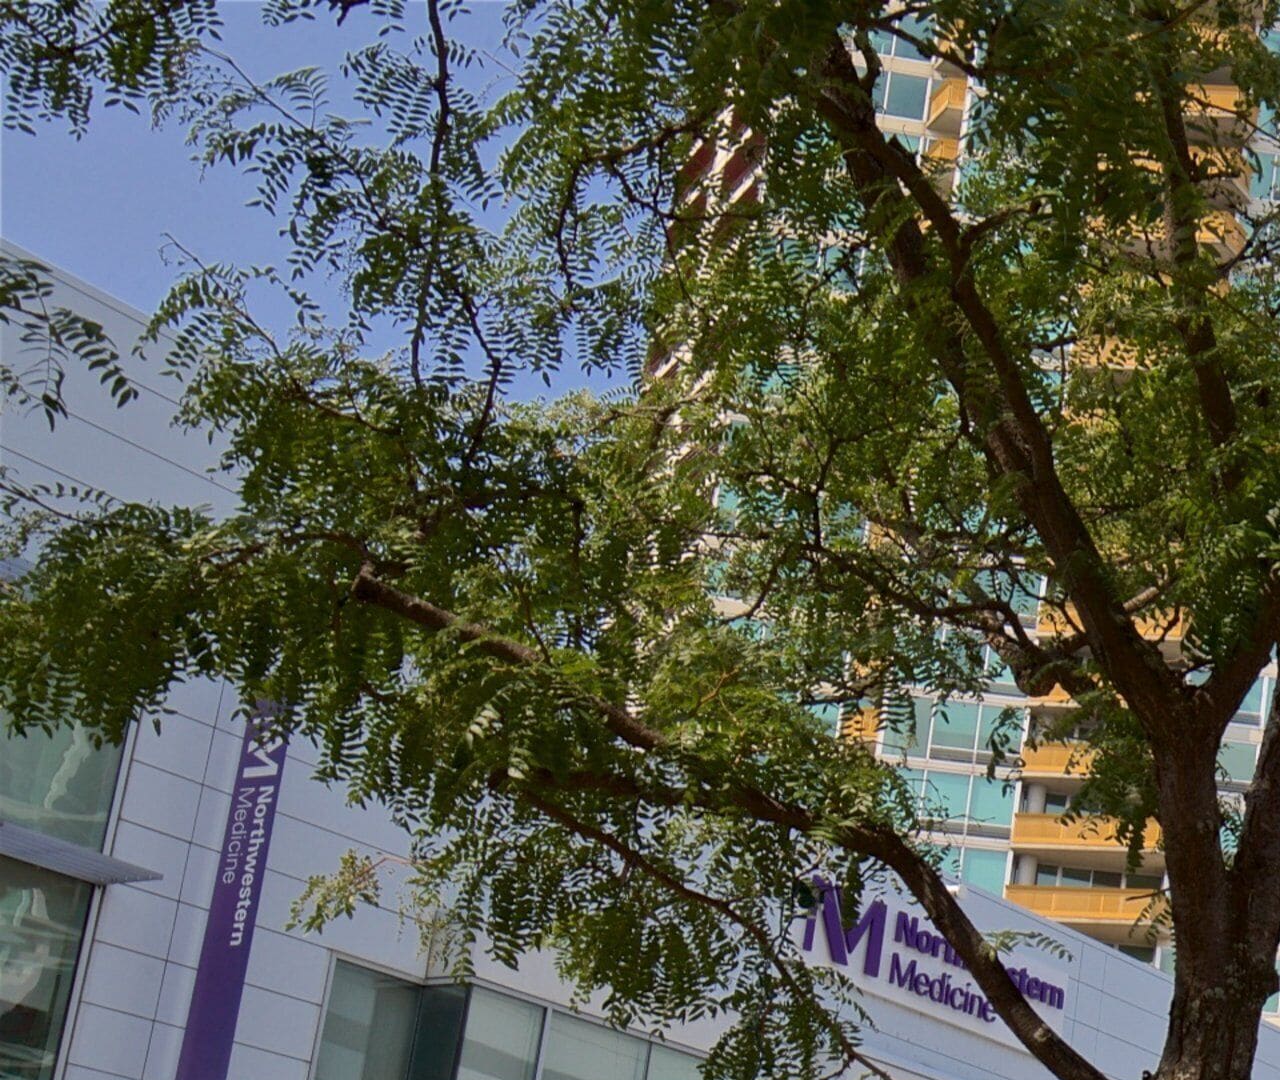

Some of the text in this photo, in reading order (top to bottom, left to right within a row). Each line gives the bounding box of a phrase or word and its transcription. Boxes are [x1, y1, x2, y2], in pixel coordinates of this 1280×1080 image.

[222, 786, 256, 885] Medicine
[228, 785, 275, 948] Northwestern
[888, 953, 997, 1023] Medicine
